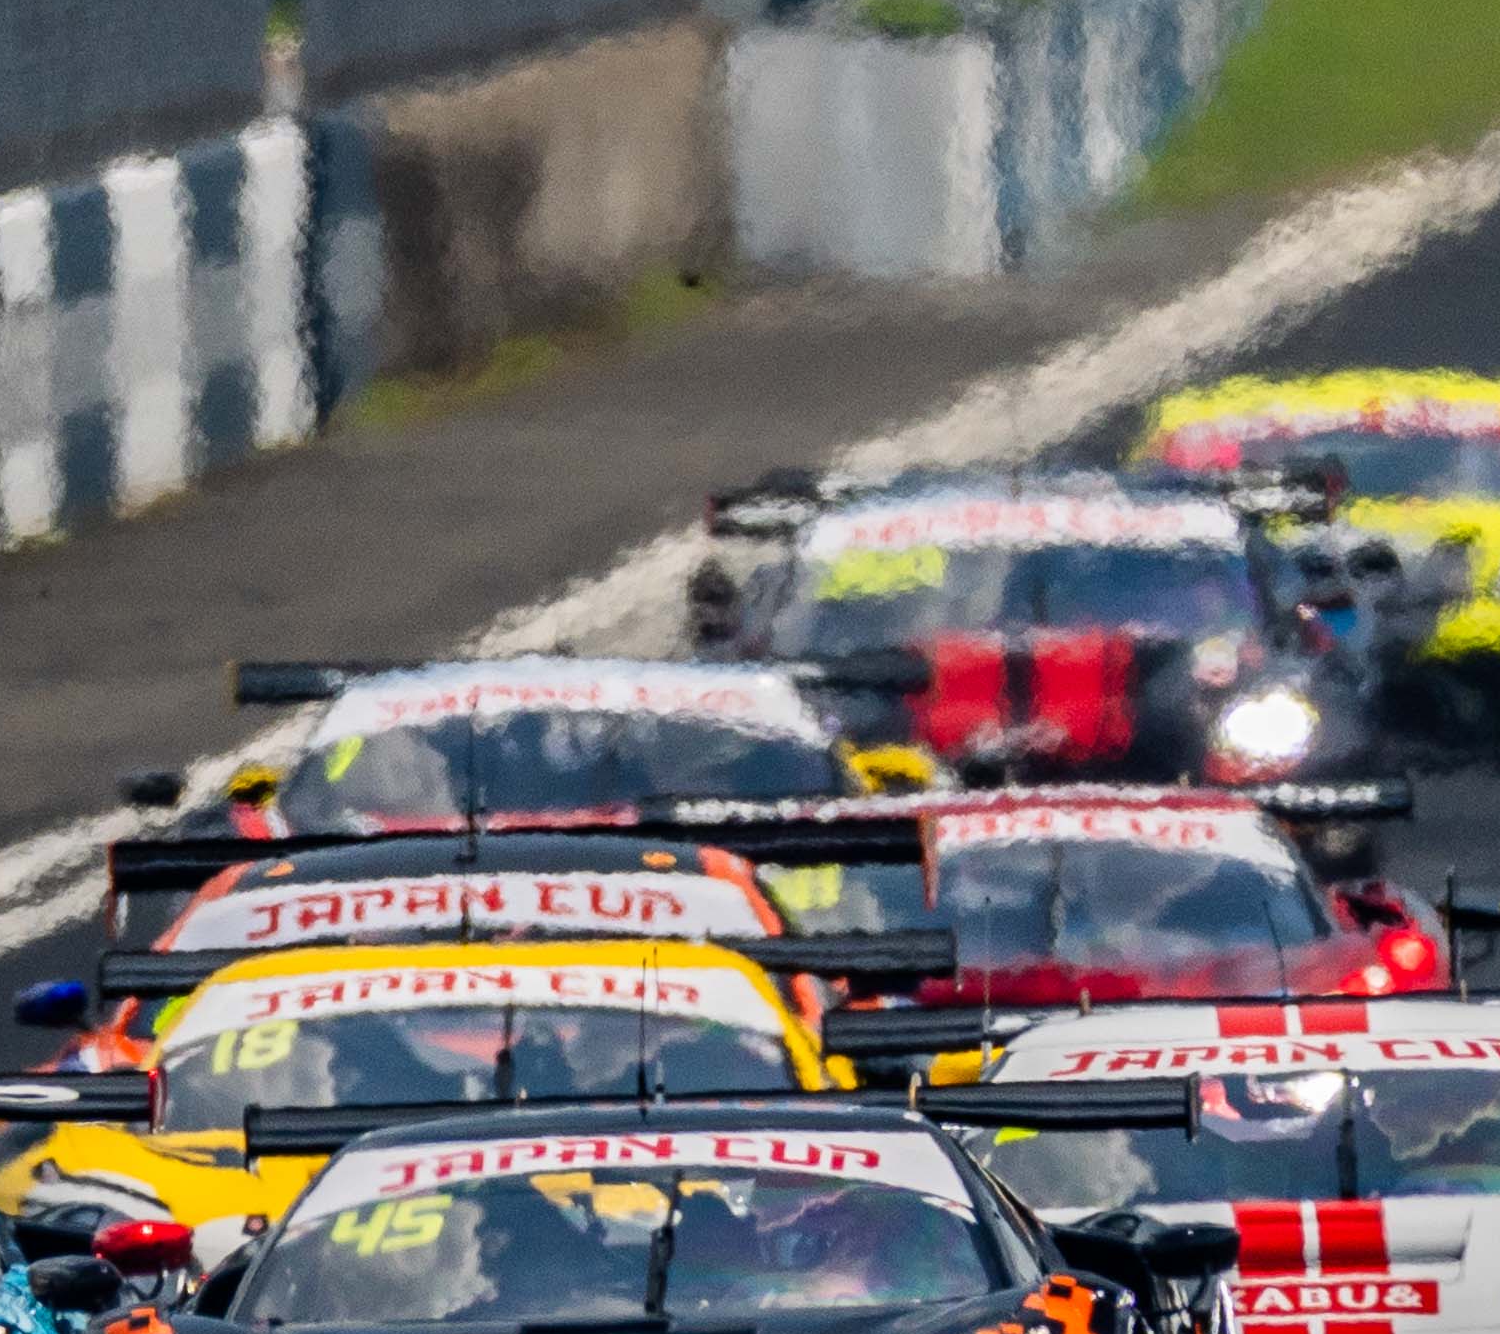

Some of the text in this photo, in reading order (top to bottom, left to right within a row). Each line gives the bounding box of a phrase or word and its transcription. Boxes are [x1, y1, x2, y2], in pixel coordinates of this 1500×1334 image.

[246, 881, 686, 942] JAPAN CUP
[246, 970, 701, 1022] JAPAN CUP
[212, 1019, 299, 1074] 18
[1050, 1039, 1345, 1079] JAPAN
[378, 1133, 881, 1194] JAPAN CUP
[330, 1193, 455, 1258] 45
